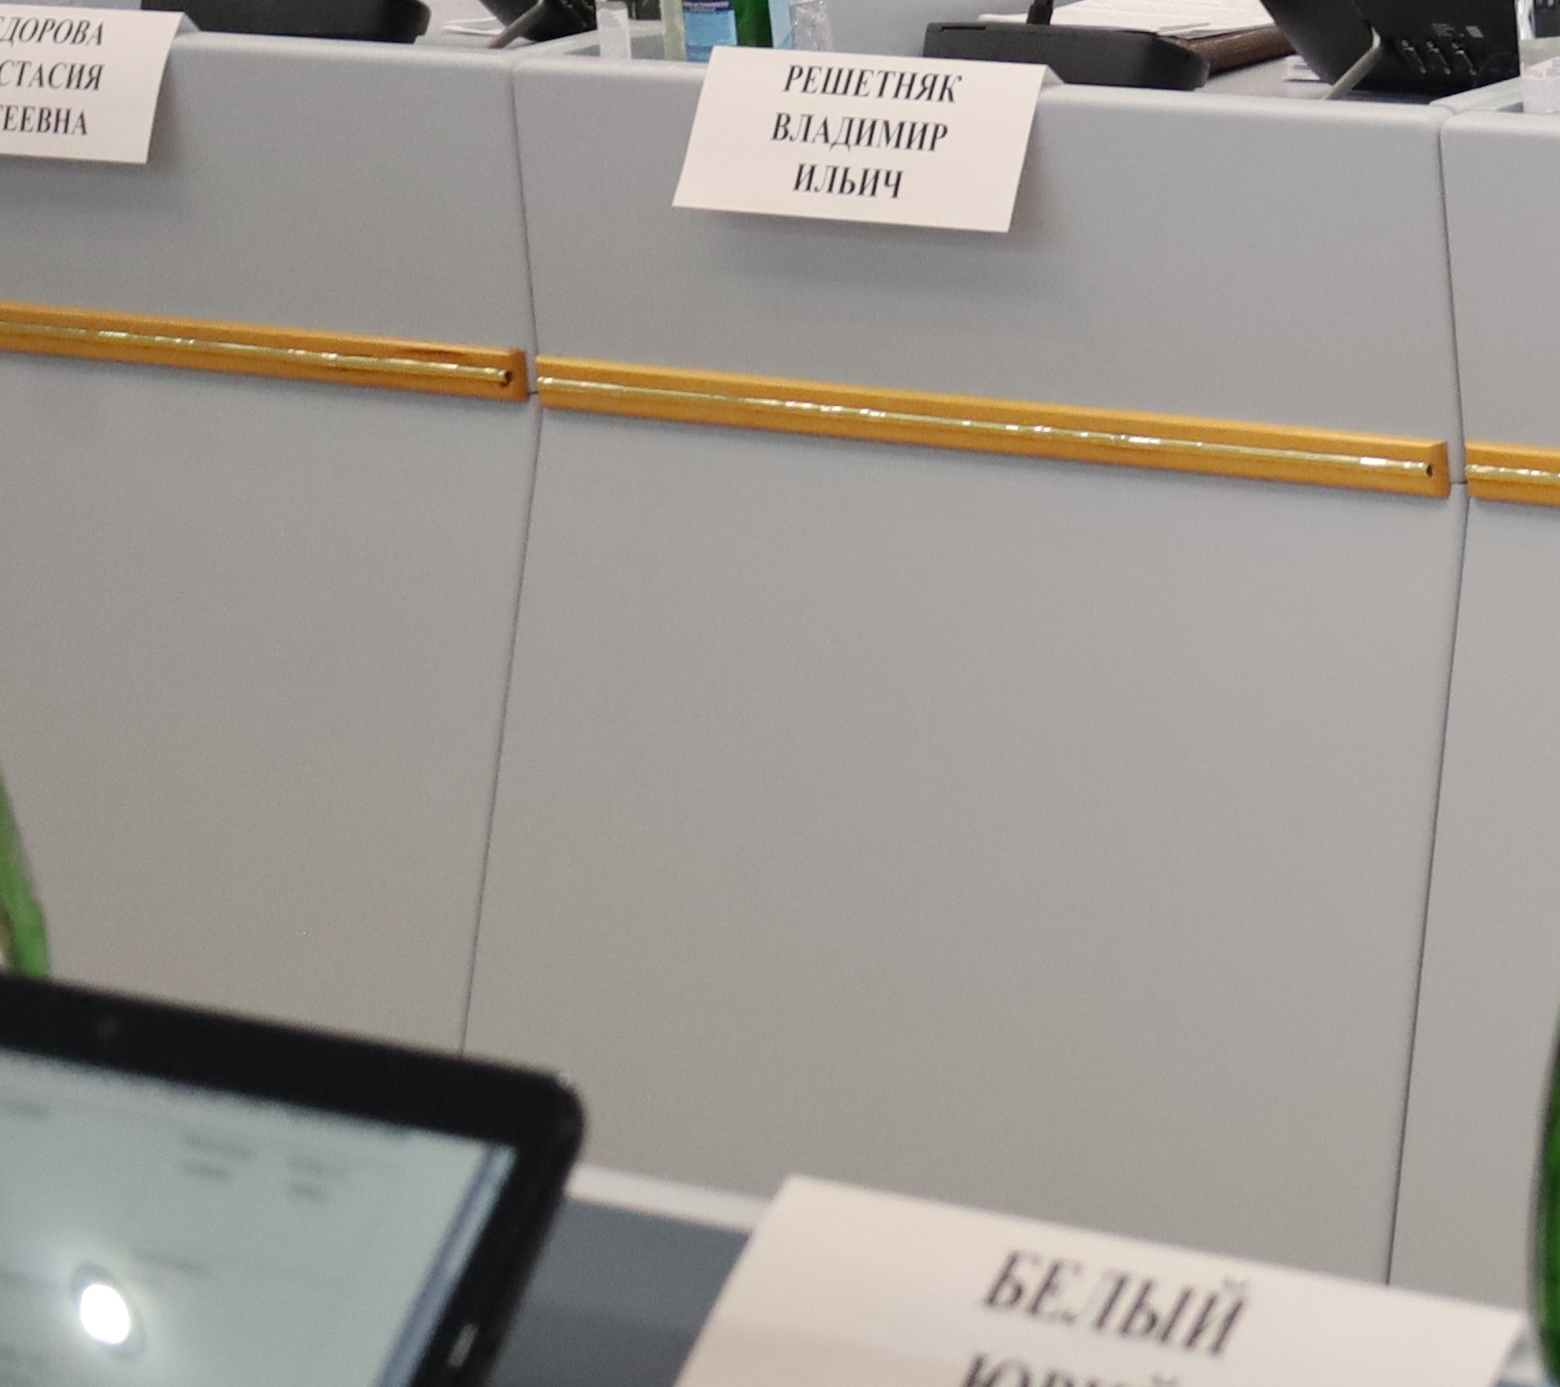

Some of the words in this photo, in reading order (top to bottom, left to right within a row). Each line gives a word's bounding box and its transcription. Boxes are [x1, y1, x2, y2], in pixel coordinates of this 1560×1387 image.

[0, 16, 104, 47] ДОРОВА
[783, 65, 963, 103] РЕШЕТНЯК
[0, 104, 88, 136] ЕЕВНА
[771, 112, 949, 152] ВЛАДИМИР
[792, 163, 904, 199] ИЛЬИЧ
[981, 1249, 1250, 1358] БЕЛЫЙ
